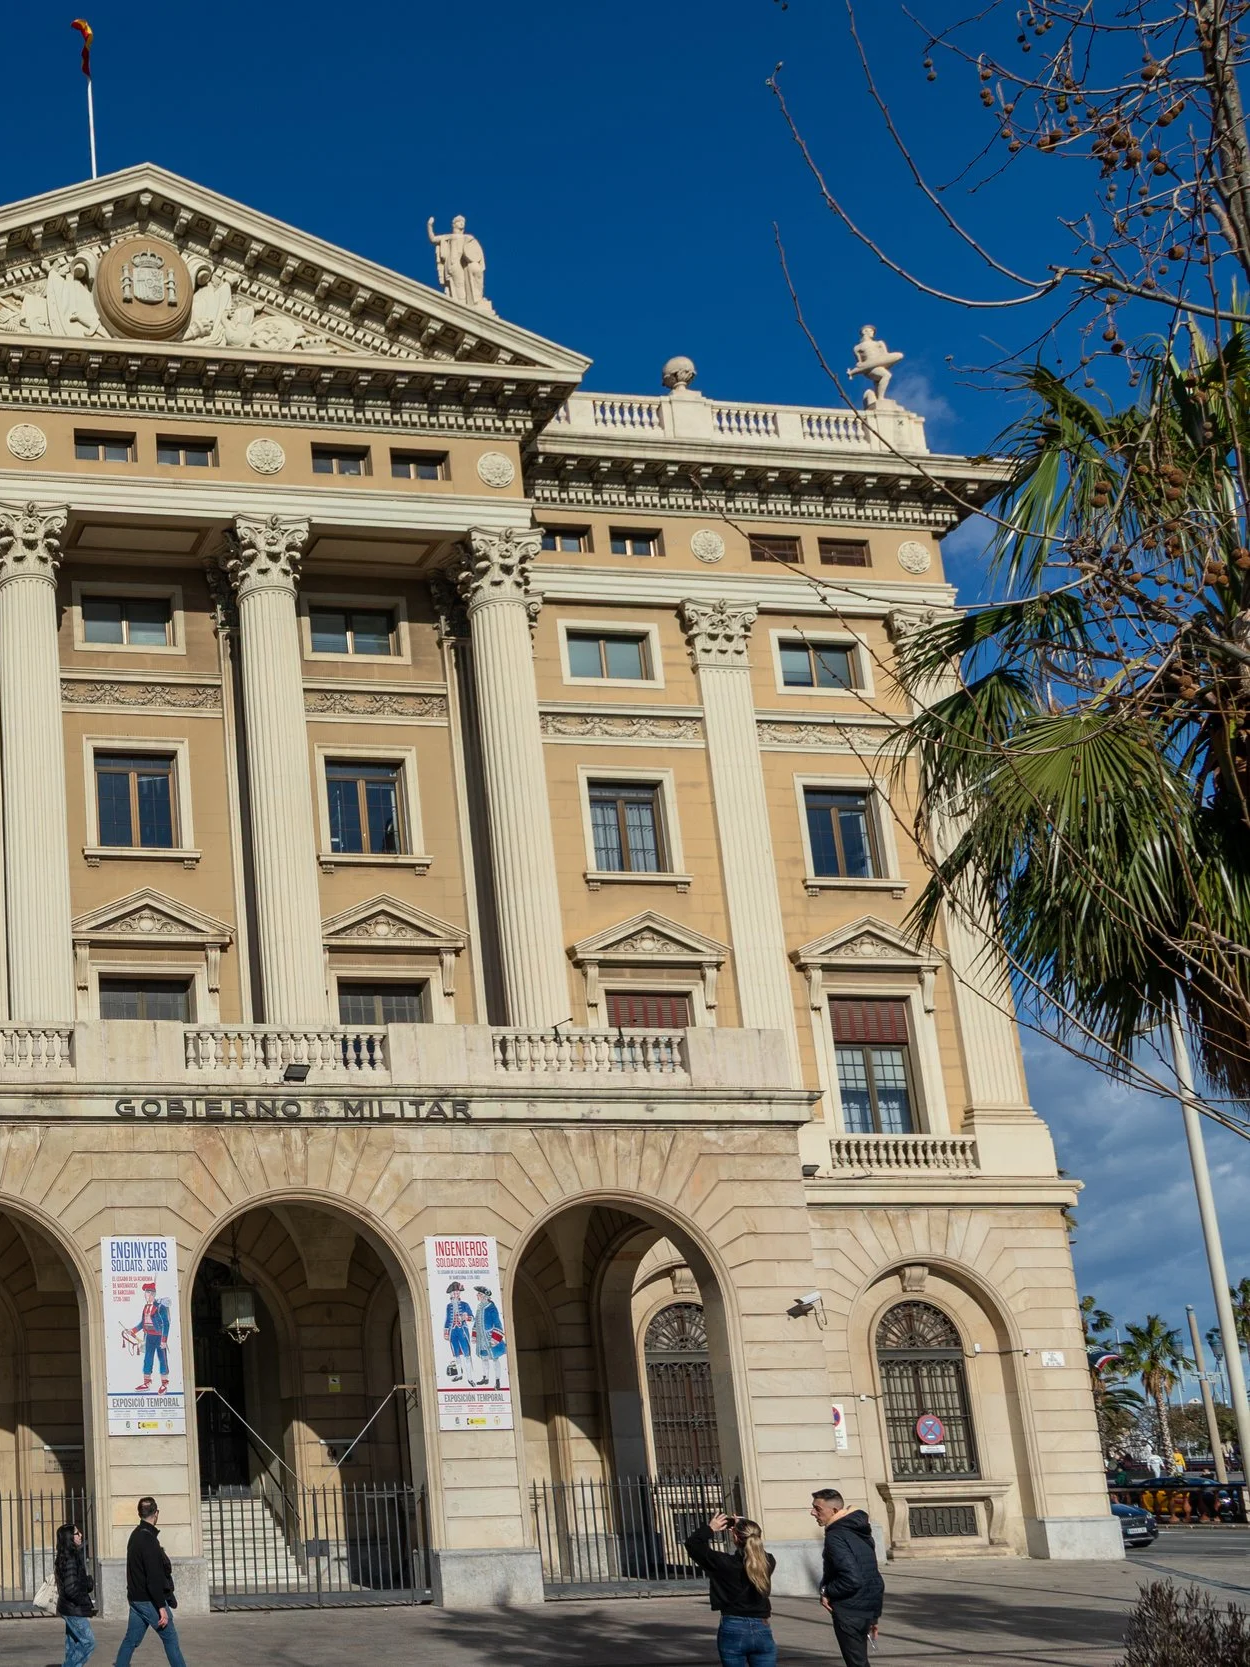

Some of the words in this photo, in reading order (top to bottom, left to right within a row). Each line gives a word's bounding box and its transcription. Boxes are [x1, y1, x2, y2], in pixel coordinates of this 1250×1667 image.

[115, 1099, 301, 1118] GOBIERNO
[343, 1099, 473, 1120] MILITAR
[110, 1241, 168, 1259] ENGINYERS
[434, 1240, 488, 1257] INGENIEROS
[111, 1259, 145, 1272] SOLDATS.
[146, 1259, 168, 1272] SAVIS
[435, 1257, 468, 1268] SOLDADOS.
[467, 1257, 489, 1268] SABIOS
[112, 1396, 145, 1408] EXPOSICIÓ
[146, 1397, 180, 1407] TEMPORAL
[444, 1392, 476, 1403] EXPOSICIÓN
[476, 1393, 505, 1402] TEMPORAL
